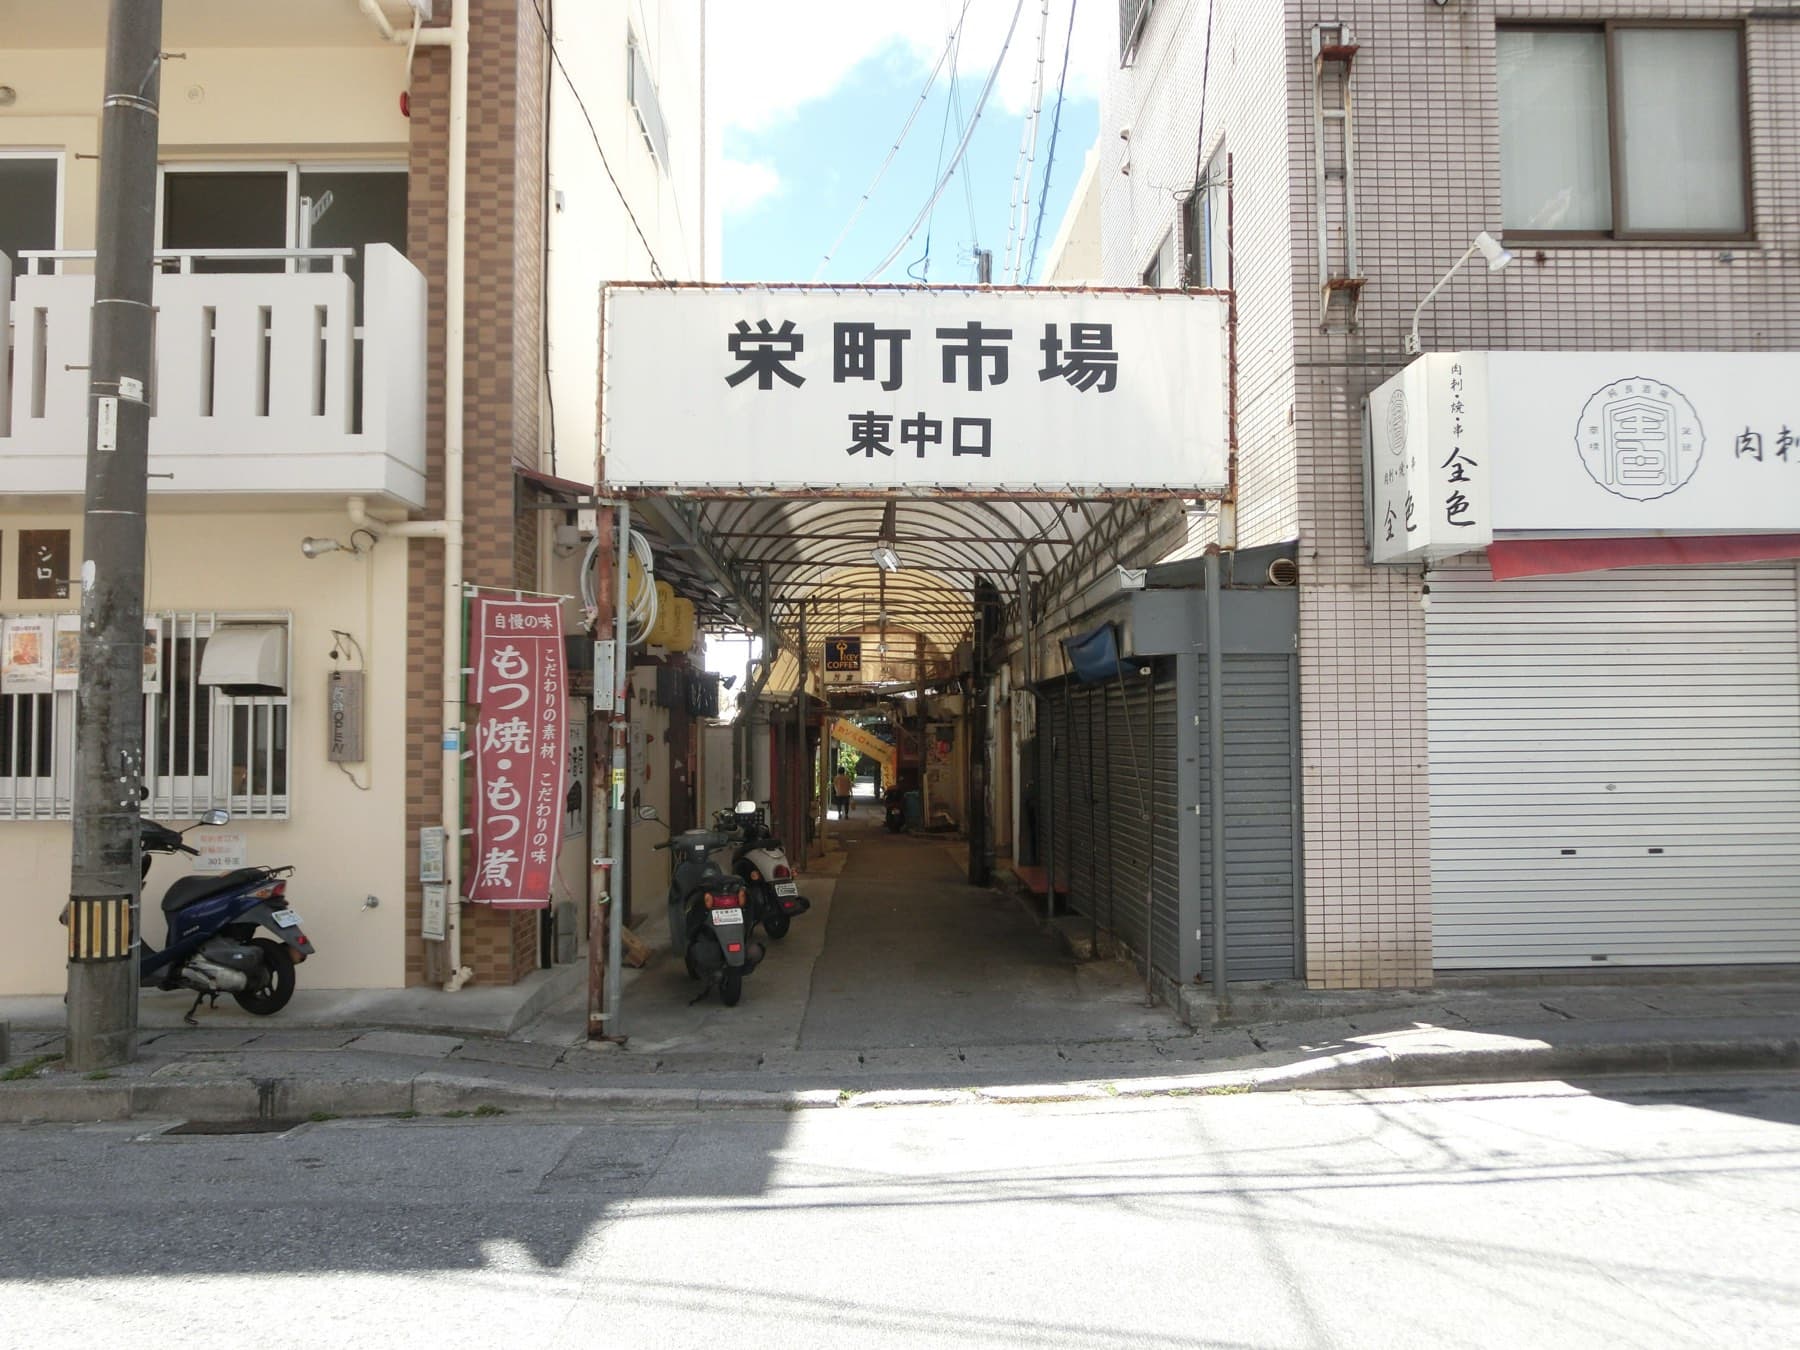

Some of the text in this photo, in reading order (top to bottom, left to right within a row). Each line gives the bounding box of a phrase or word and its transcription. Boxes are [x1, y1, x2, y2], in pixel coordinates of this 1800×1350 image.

[725, 318, 1119, 392] 栄町市場
[847, 411, 992, 458] 東中口
[1440, 446, 1478, 526] 全色
[37, 545, 52, 580] シロ
[494, 613, 553, 630] 自慢の味
[481, 645, 531, 888] もつ焼・もつ煮
